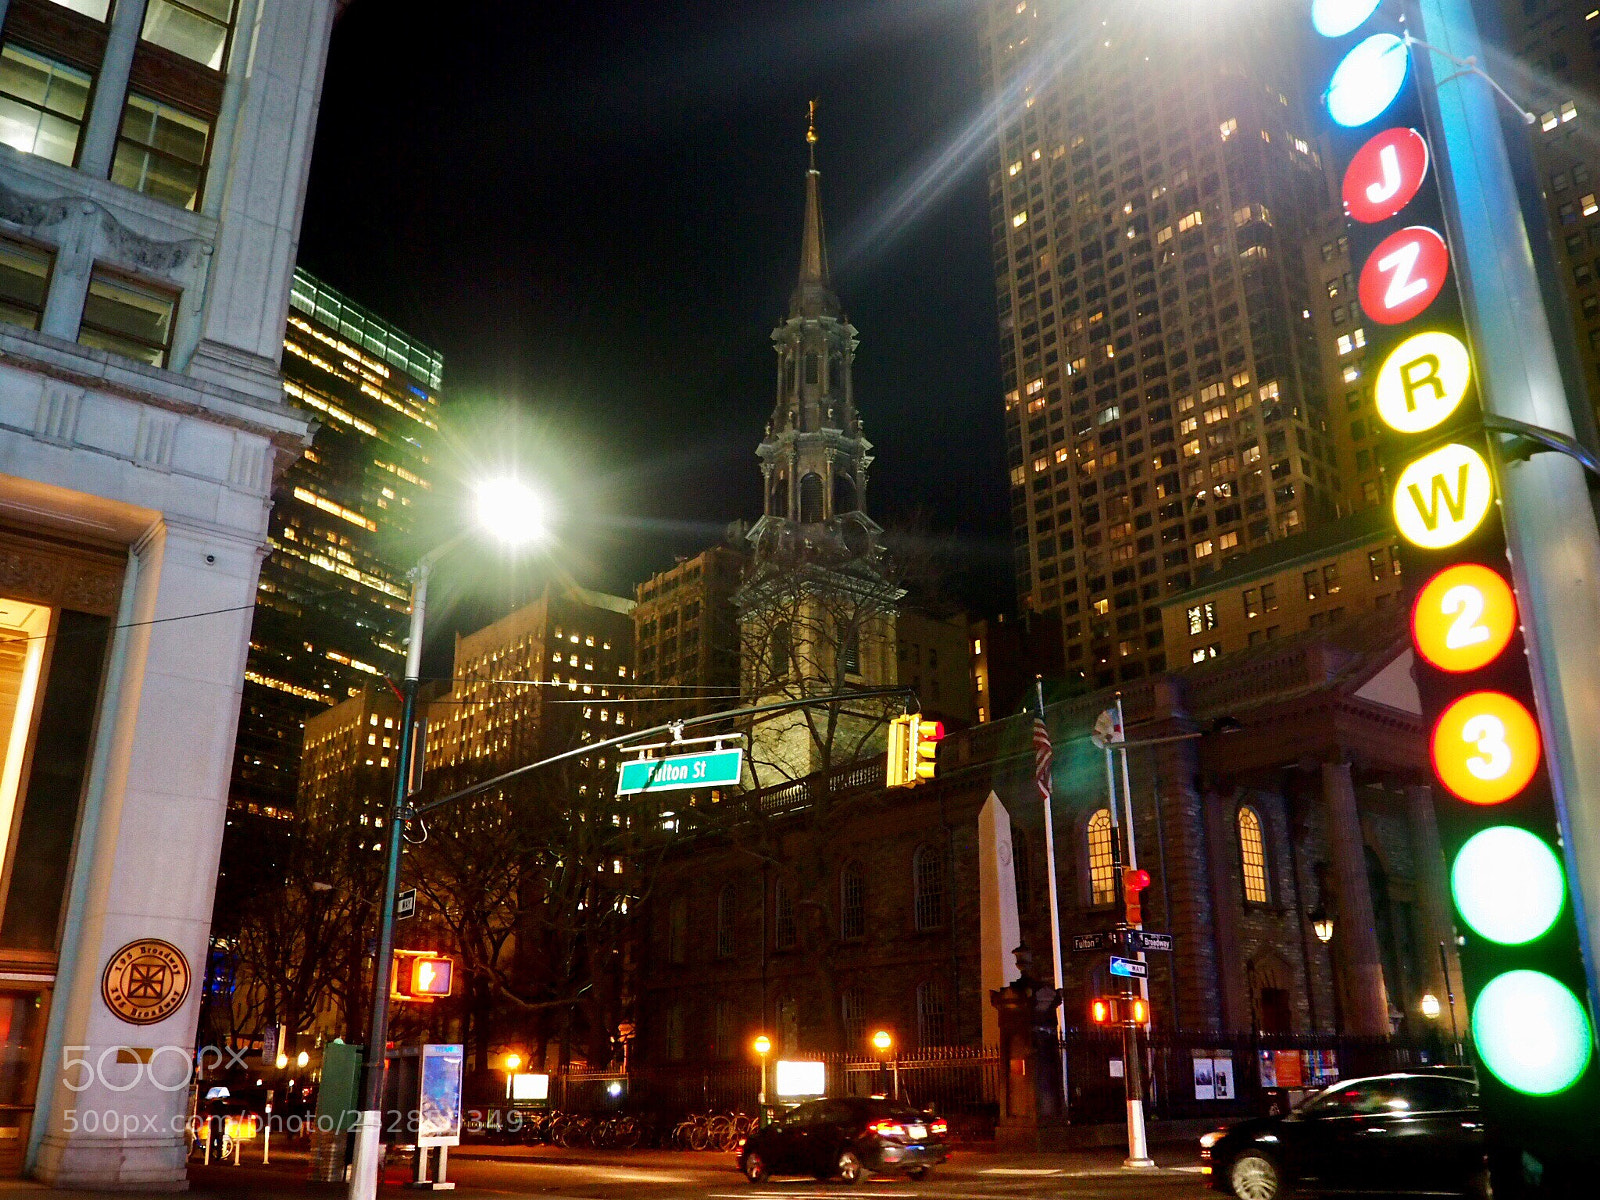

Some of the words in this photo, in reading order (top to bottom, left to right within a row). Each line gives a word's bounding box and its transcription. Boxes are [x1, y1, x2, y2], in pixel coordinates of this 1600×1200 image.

[1366, 144, 1402, 203] J
[1378, 241, 1429, 308] Z
[1400, 353, 1447, 413] R
[1407, 463, 1470, 532] W
[1441, 585, 1490, 649] 2
[1461, 714, 1512, 780] 3
[693, 761, 707, 779] St
[114, 952, 133, 972] 195
[140, 946, 181, 975] Broadway
[1075, 939, 1095, 949] Fulton
[1144, 937, 1170, 949] Broadway
[1131, 965, 1143, 973] WAY
[111, 986, 127, 1008] 195
[131, 990, 180, 1017] Broadway
